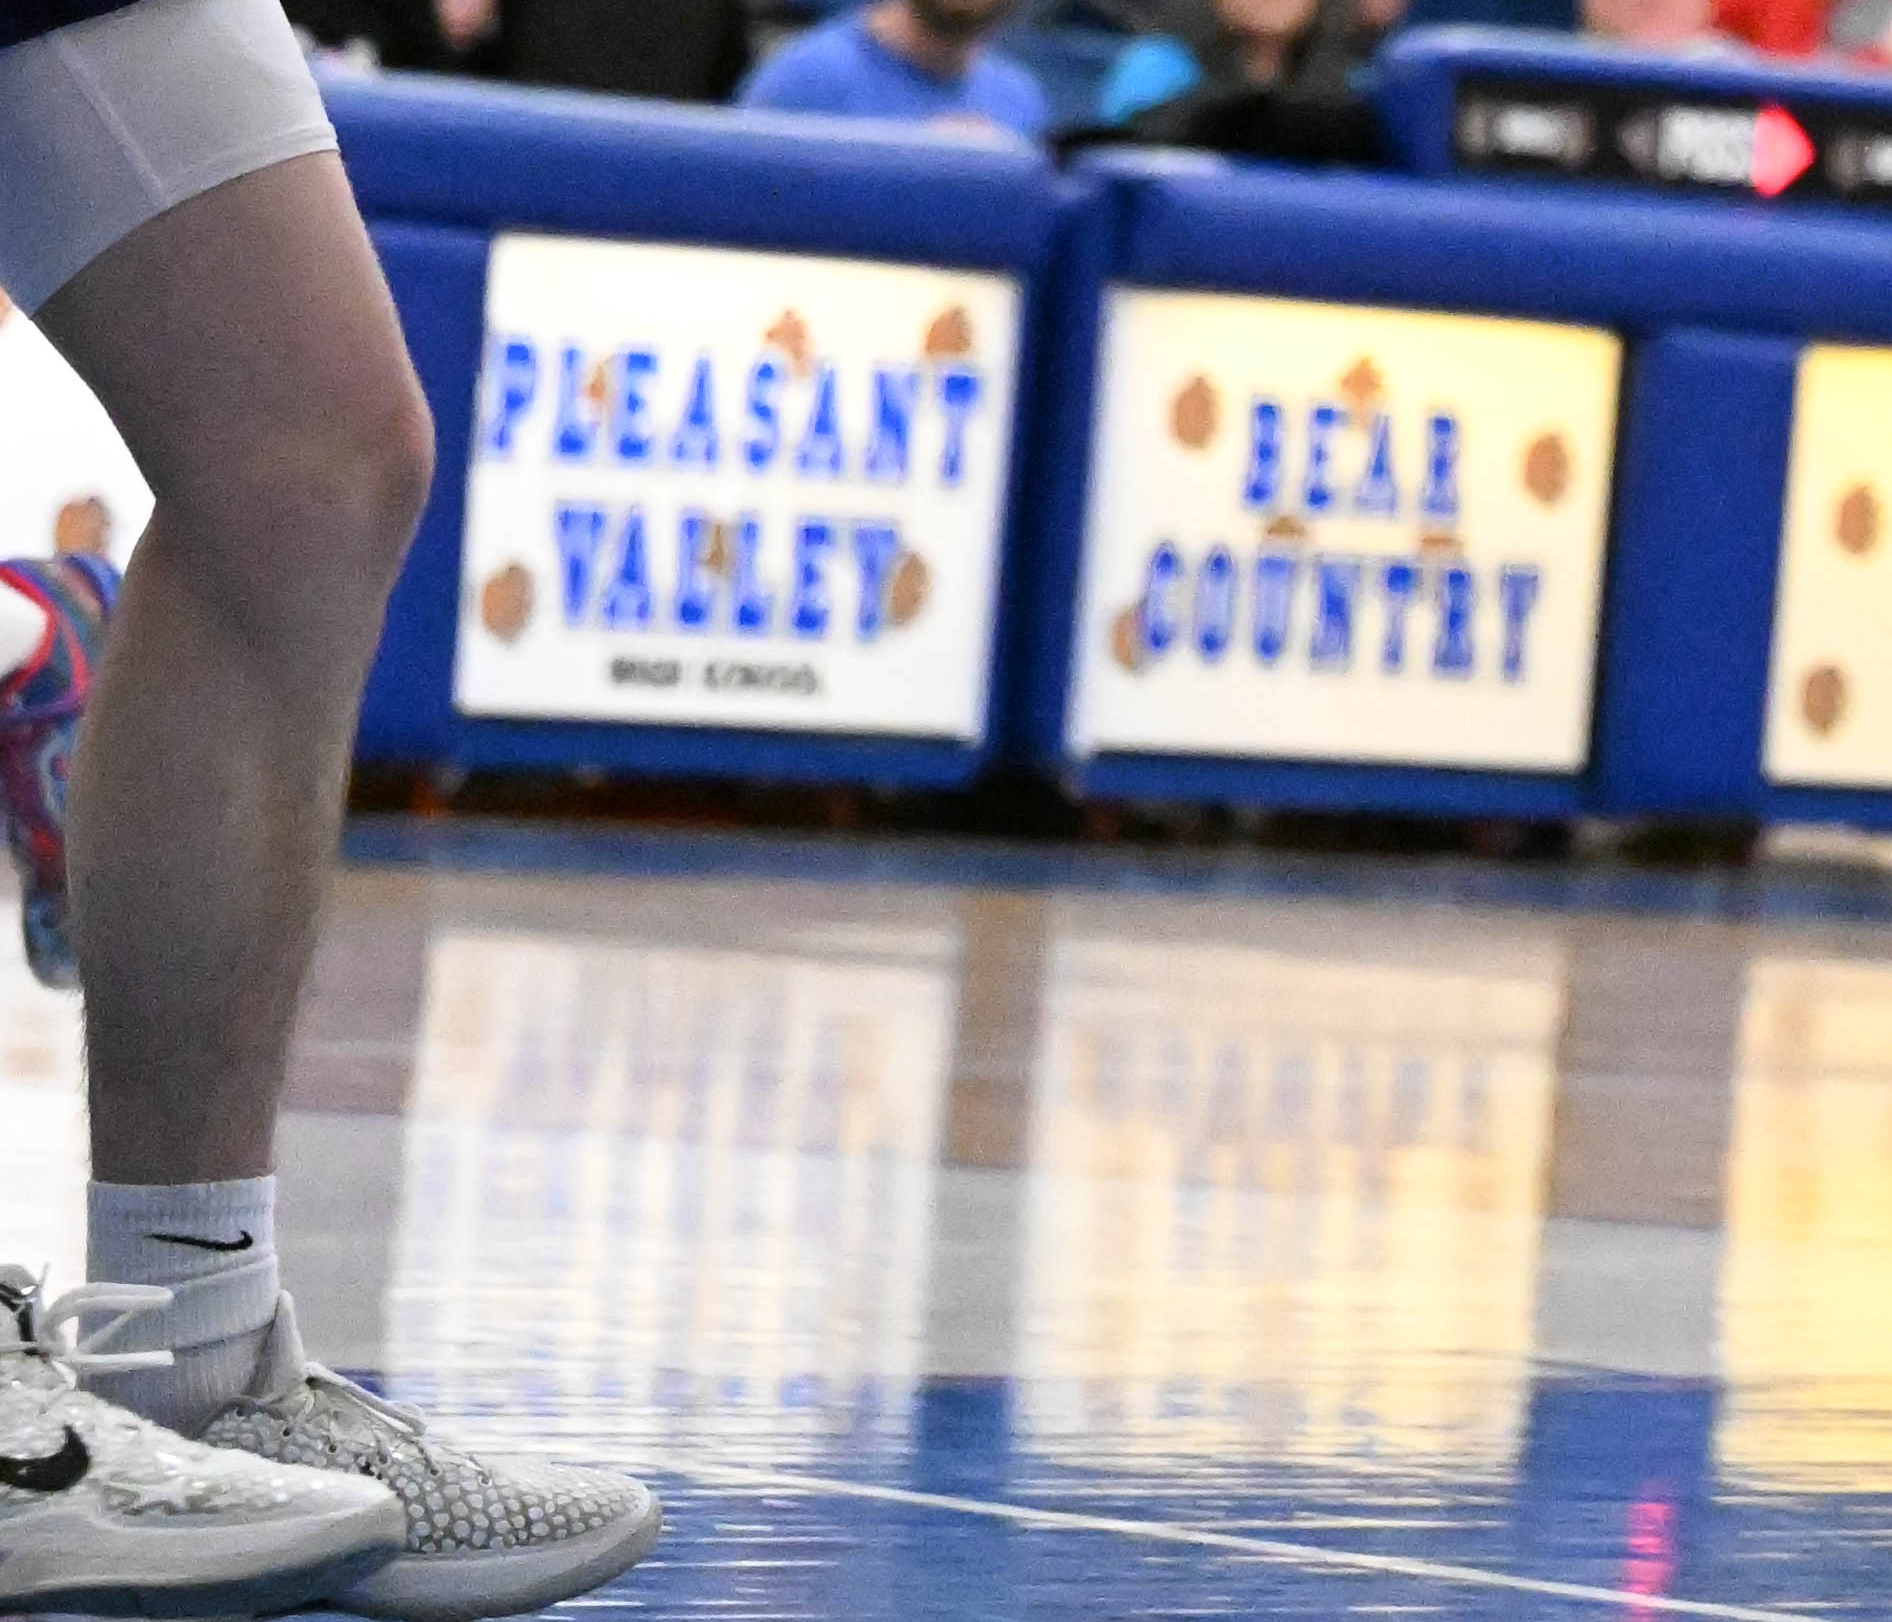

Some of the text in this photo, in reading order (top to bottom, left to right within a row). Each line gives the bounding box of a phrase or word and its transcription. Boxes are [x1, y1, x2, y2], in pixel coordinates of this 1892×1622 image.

[483, 334, 988, 494] PLEASANT
[554, 496, 906, 642] VALLEY
[1139, 542, 1542, 684] COUNTRY
